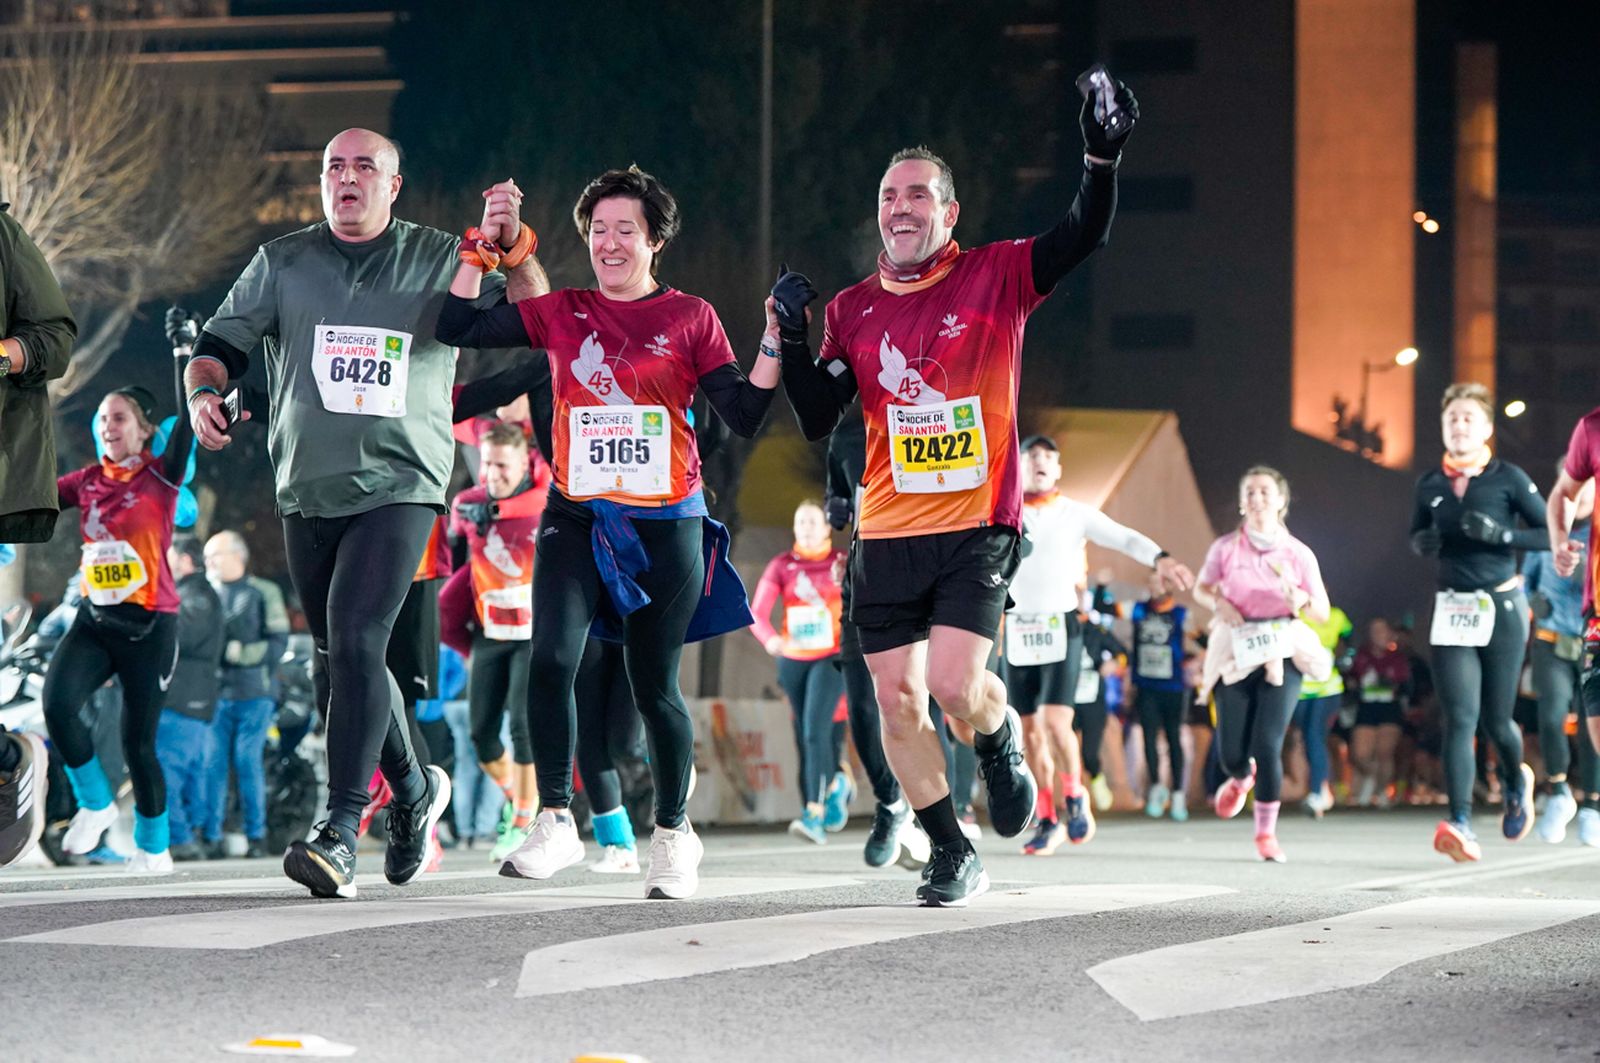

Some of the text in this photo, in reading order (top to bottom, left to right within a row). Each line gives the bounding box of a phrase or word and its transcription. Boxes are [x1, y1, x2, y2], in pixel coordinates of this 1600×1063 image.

[336, 335, 364, 345] NOCHE
[366, 337, 378, 346] DE
[324, 345, 343, 355] SAN
[344, 345, 377, 357] ANTÓN
[330, 356, 392, 387] 6428
[588, 371, 612, 396] 43
[897, 377, 921, 399] 43
[592, 416, 620, 425] NOCHE
[622, 415, 633, 424] DE
[905, 415, 931, 425] NOCHE
[933, 413, 945, 422] DE
[582, 427, 599, 437] SAN
[601, 425, 633, 437] ANTÓN
[899, 426, 914, 435] SAN
[915, 423, 947, 435] ANTÓN
[589, 438, 650, 465] 5165
[902, 431, 974, 463] 12422
[93, 563, 131, 584] 5184
[1450, 614, 1480, 628] 1758
[1023, 632, 1053, 647] 1180
